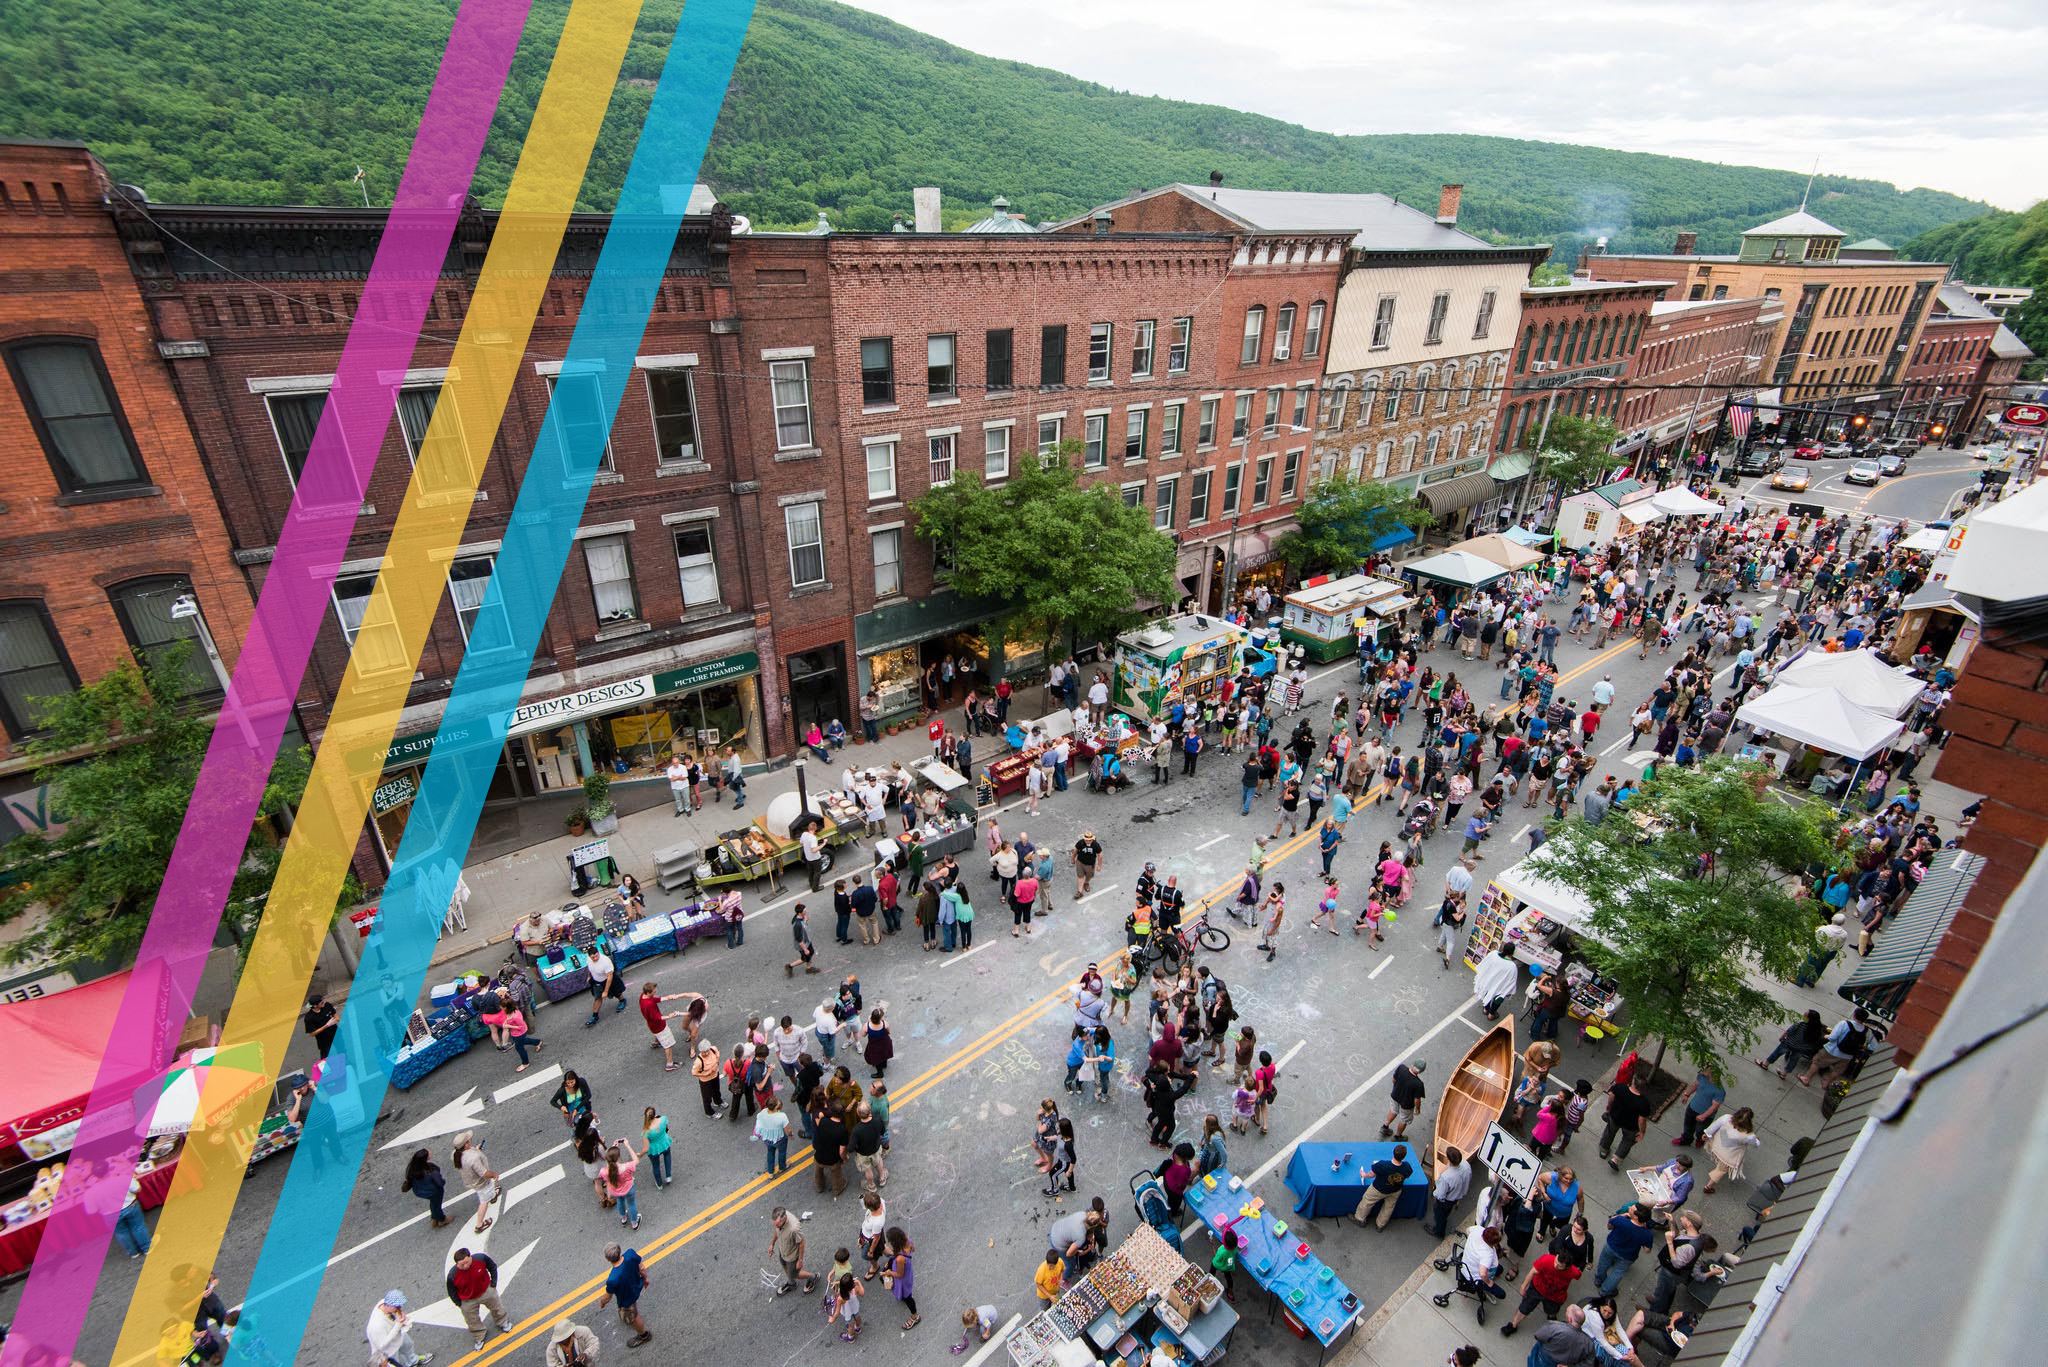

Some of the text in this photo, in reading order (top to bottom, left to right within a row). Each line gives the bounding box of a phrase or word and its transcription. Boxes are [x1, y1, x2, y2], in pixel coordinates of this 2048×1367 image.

[674, 664, 745, 687] PICTURE FRAMING
[693, 661, 726, 674] CUSTOM
[503, 697, 575, 730] ZEPHYR
[577, 679, 645, 706] DESIGNS
[372, 729, 469, 762] ART SUPPLIES
[1501, 1169, 1526, 1192] ONLY
